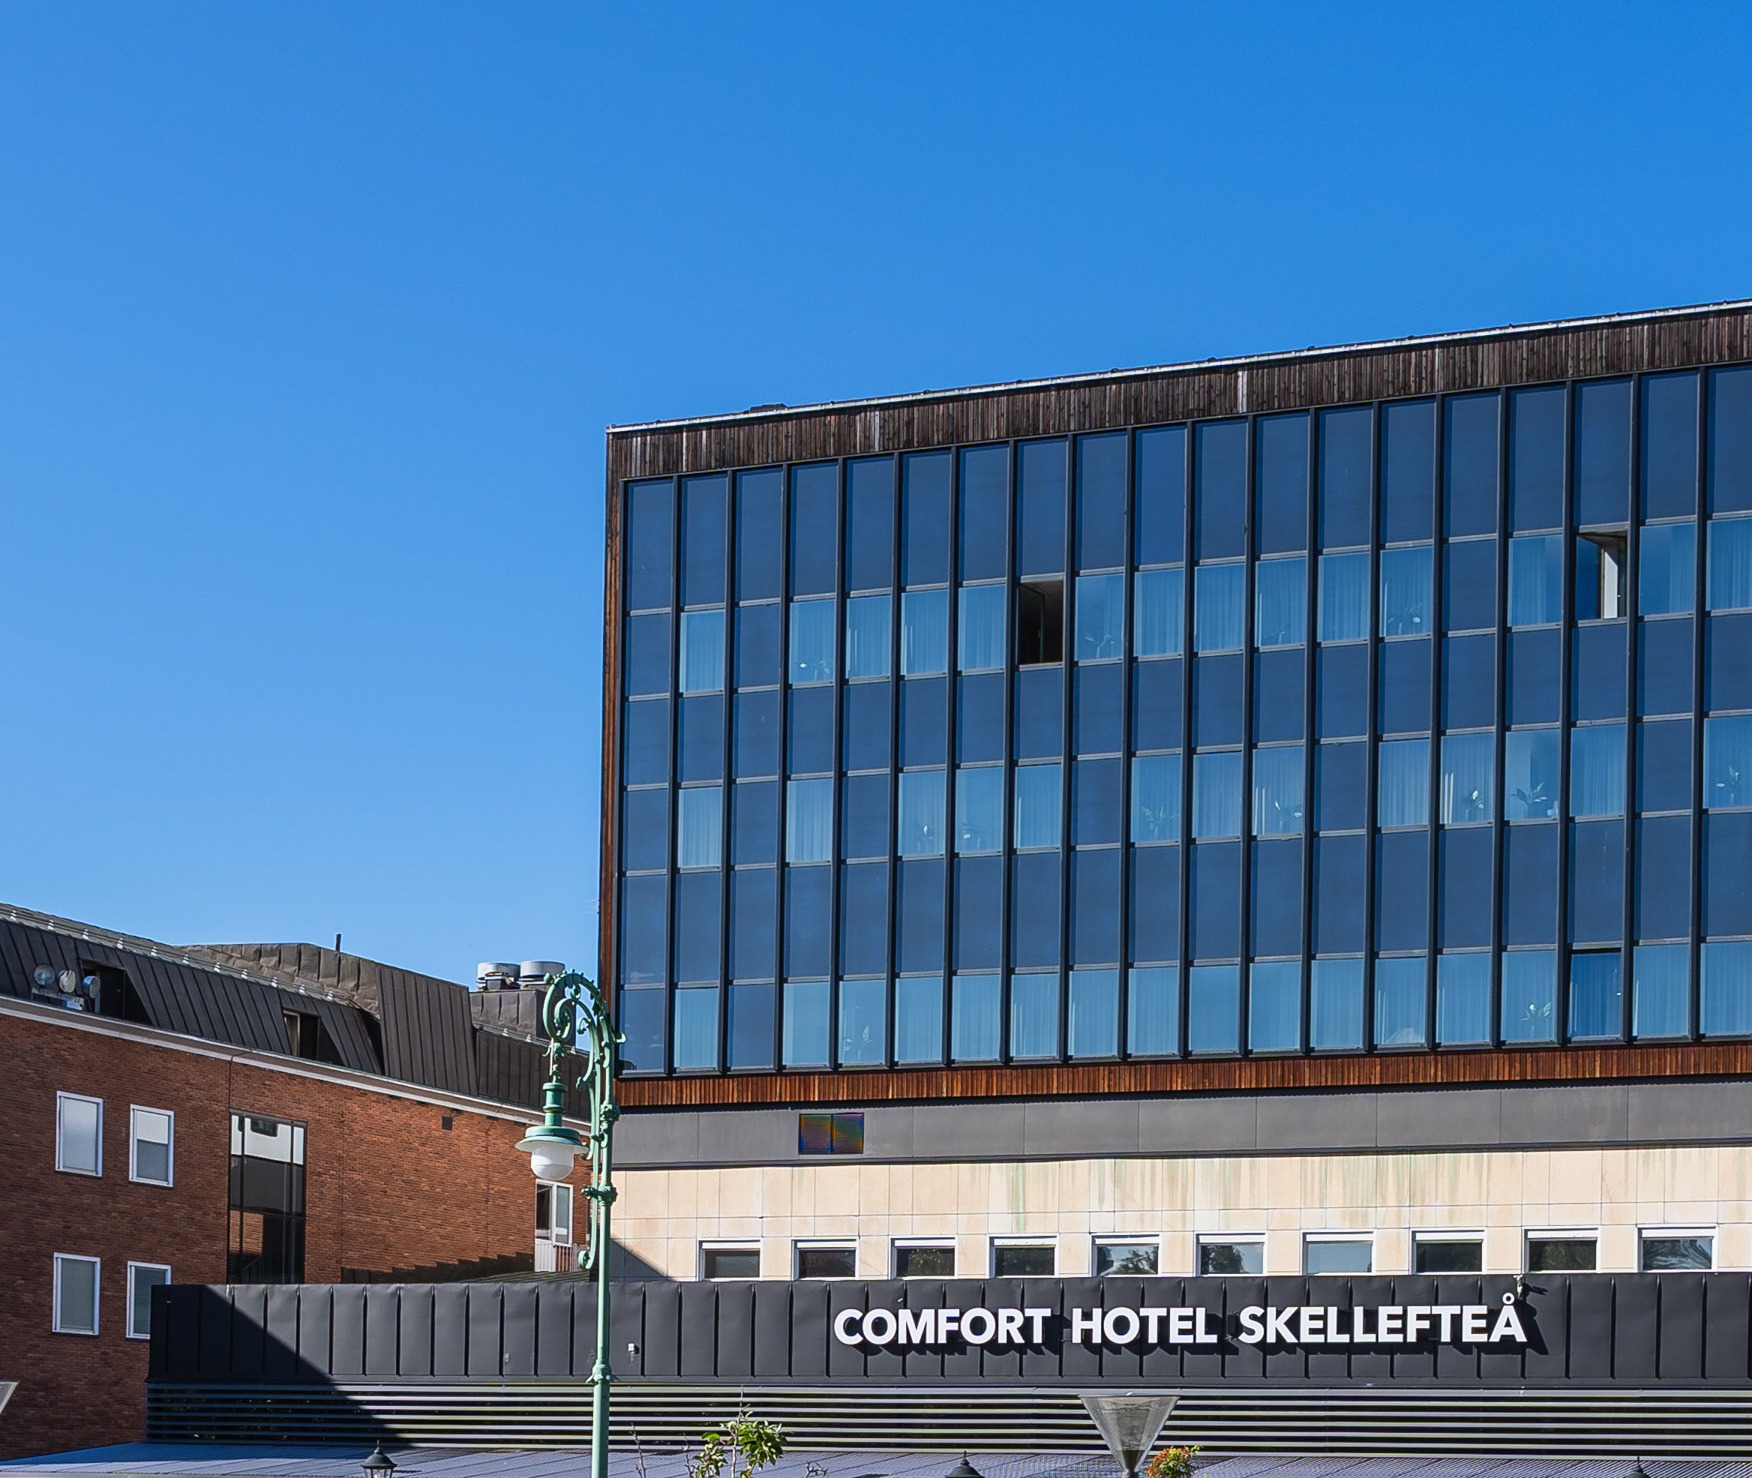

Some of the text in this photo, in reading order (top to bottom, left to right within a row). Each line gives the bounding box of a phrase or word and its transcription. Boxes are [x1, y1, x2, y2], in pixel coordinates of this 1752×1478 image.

[833, 1292, 1527, 1345] COMFORT HOTEL SKELLEFTEÅ
